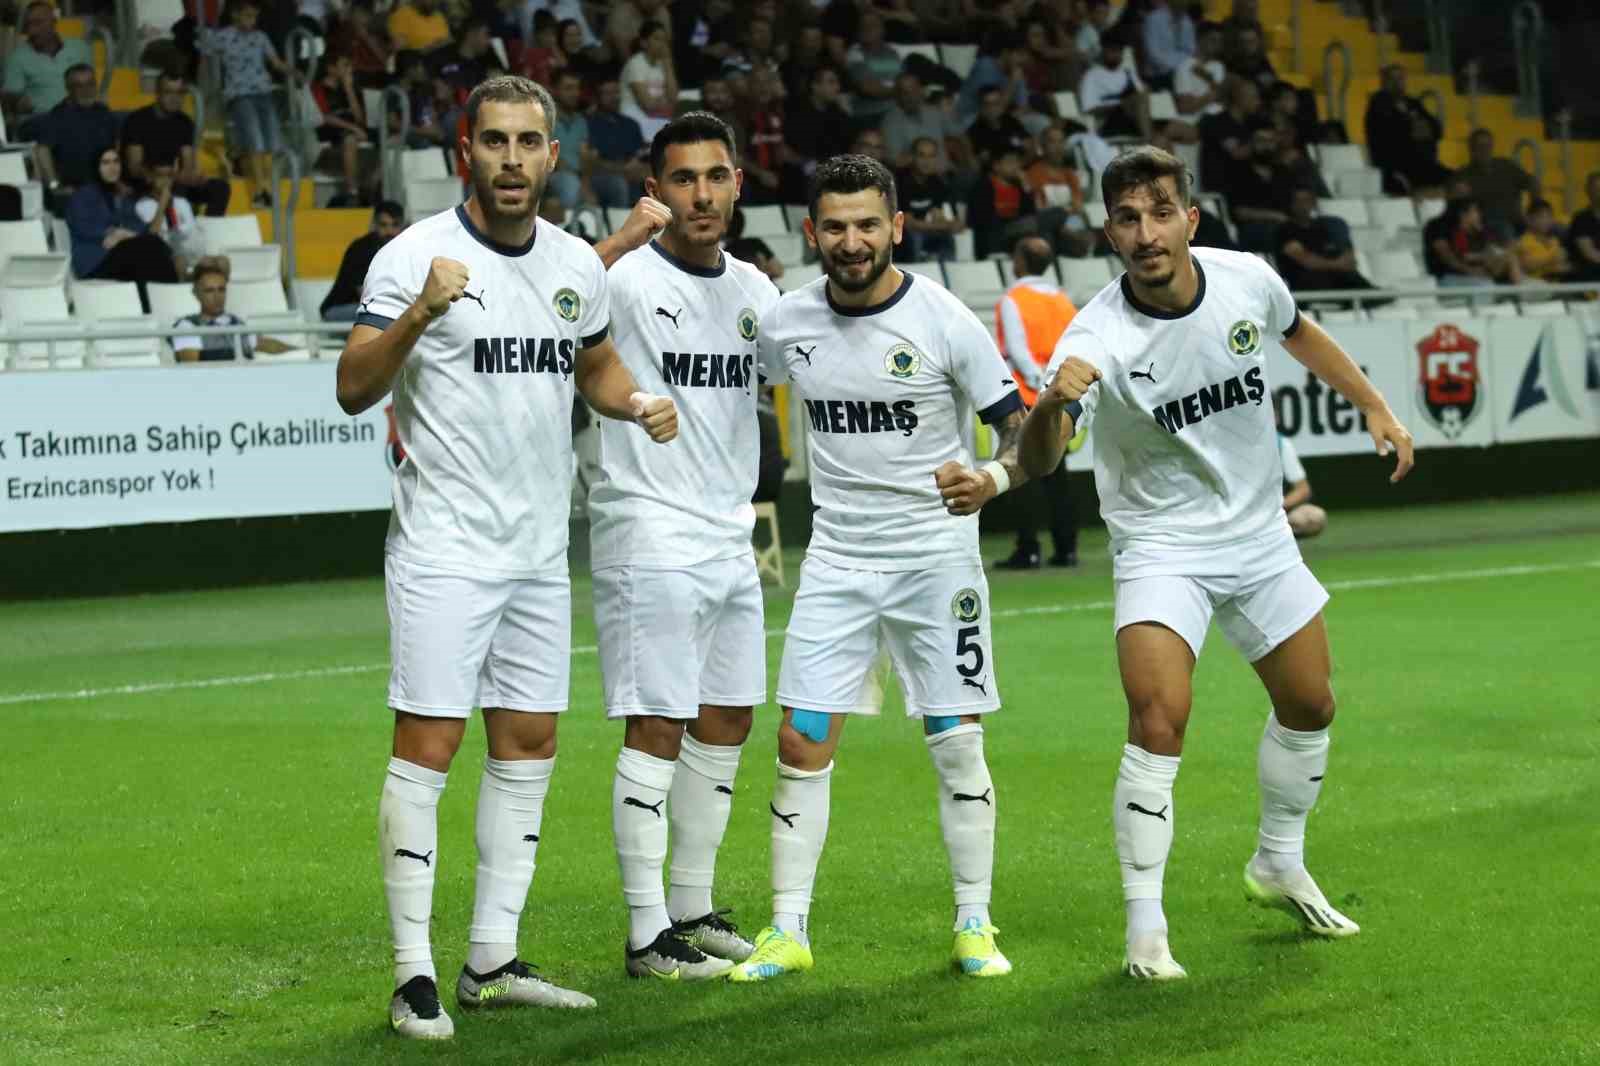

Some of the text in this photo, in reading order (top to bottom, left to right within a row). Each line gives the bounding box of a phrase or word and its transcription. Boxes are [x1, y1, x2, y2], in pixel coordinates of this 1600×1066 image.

[473, 336, 574, 381] MENAŞ
[662, 351, 753, 396] MENAŞ
[804, 398, 919, 437] MENAŞ
[1152, 366, 1265, 435] MENAŞ
[15, 429, 137, 459] Takımına
[146, 421, 221, 456] Sahip
[230, 416, 375, 456] Çıkabilirsin
[7, 471, 155, 499] Erzincanspor
[162, 469, 201, 491] Yok
[956, 625, 984, 677] 5
